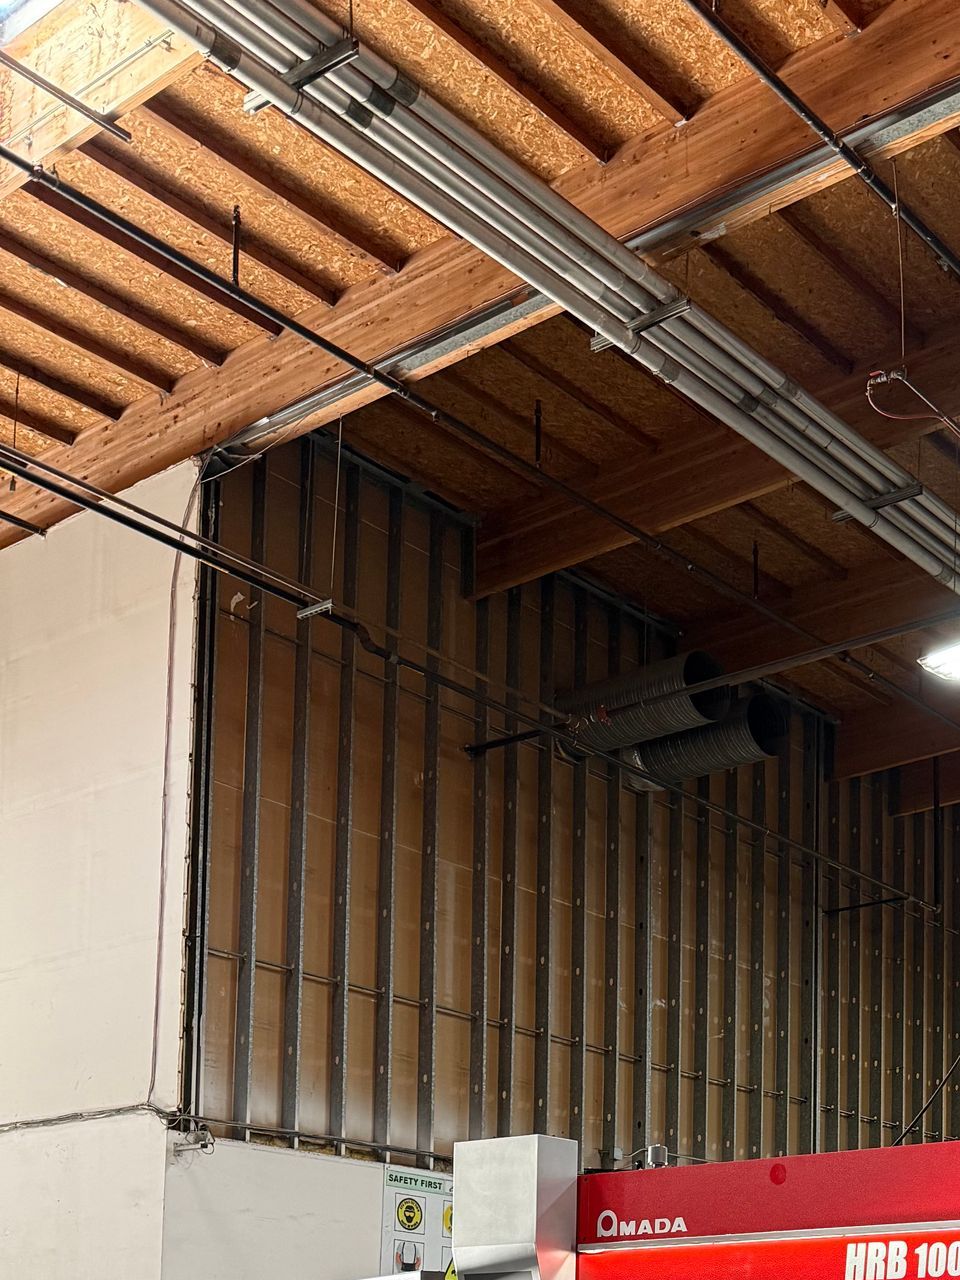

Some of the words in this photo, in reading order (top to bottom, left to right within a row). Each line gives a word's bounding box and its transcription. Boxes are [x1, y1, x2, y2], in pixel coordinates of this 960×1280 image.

[388, 1173, 419, 1186] SAFETY
[420, 1179, 443, 1190] FIRST
[597, 1209, 688, 1238] AMADA
